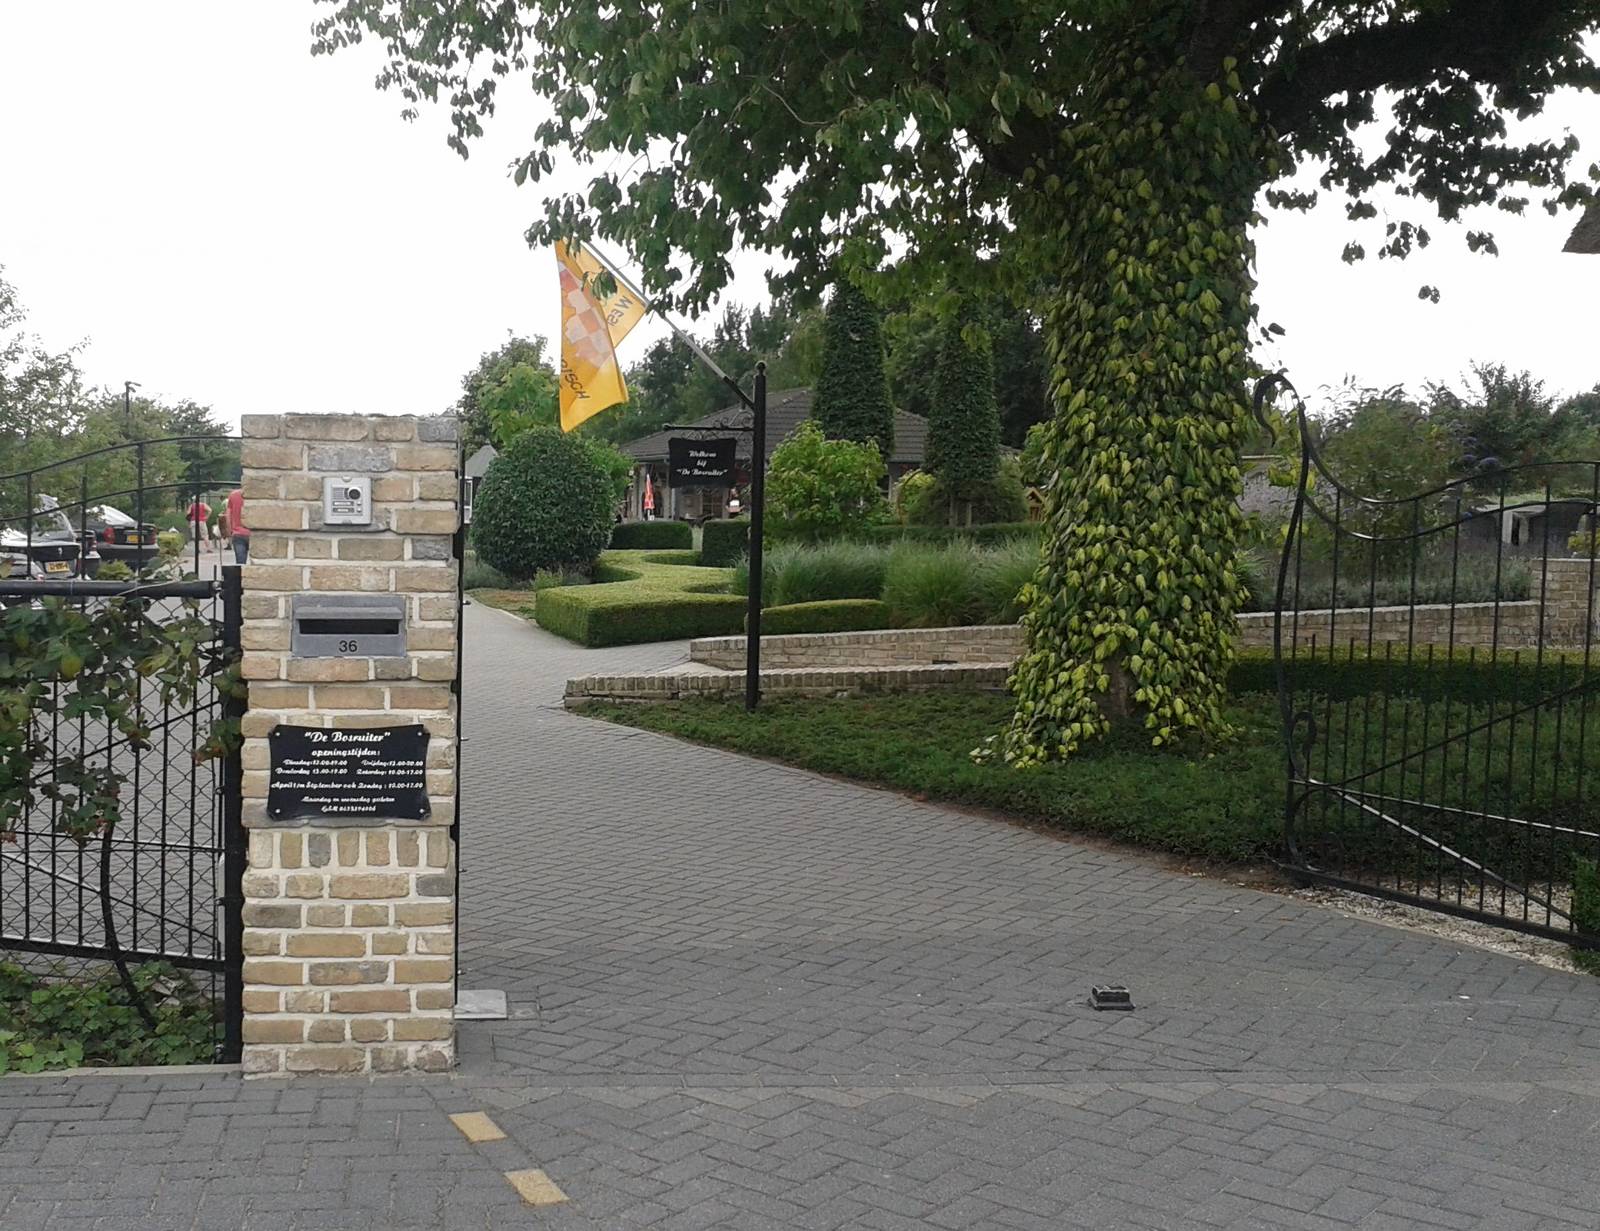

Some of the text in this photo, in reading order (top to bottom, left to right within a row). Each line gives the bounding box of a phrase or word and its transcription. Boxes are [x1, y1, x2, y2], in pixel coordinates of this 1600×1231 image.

[338, 640, 358, 653] 36
[304, 731, 391, 743] "De Bosruiter"
